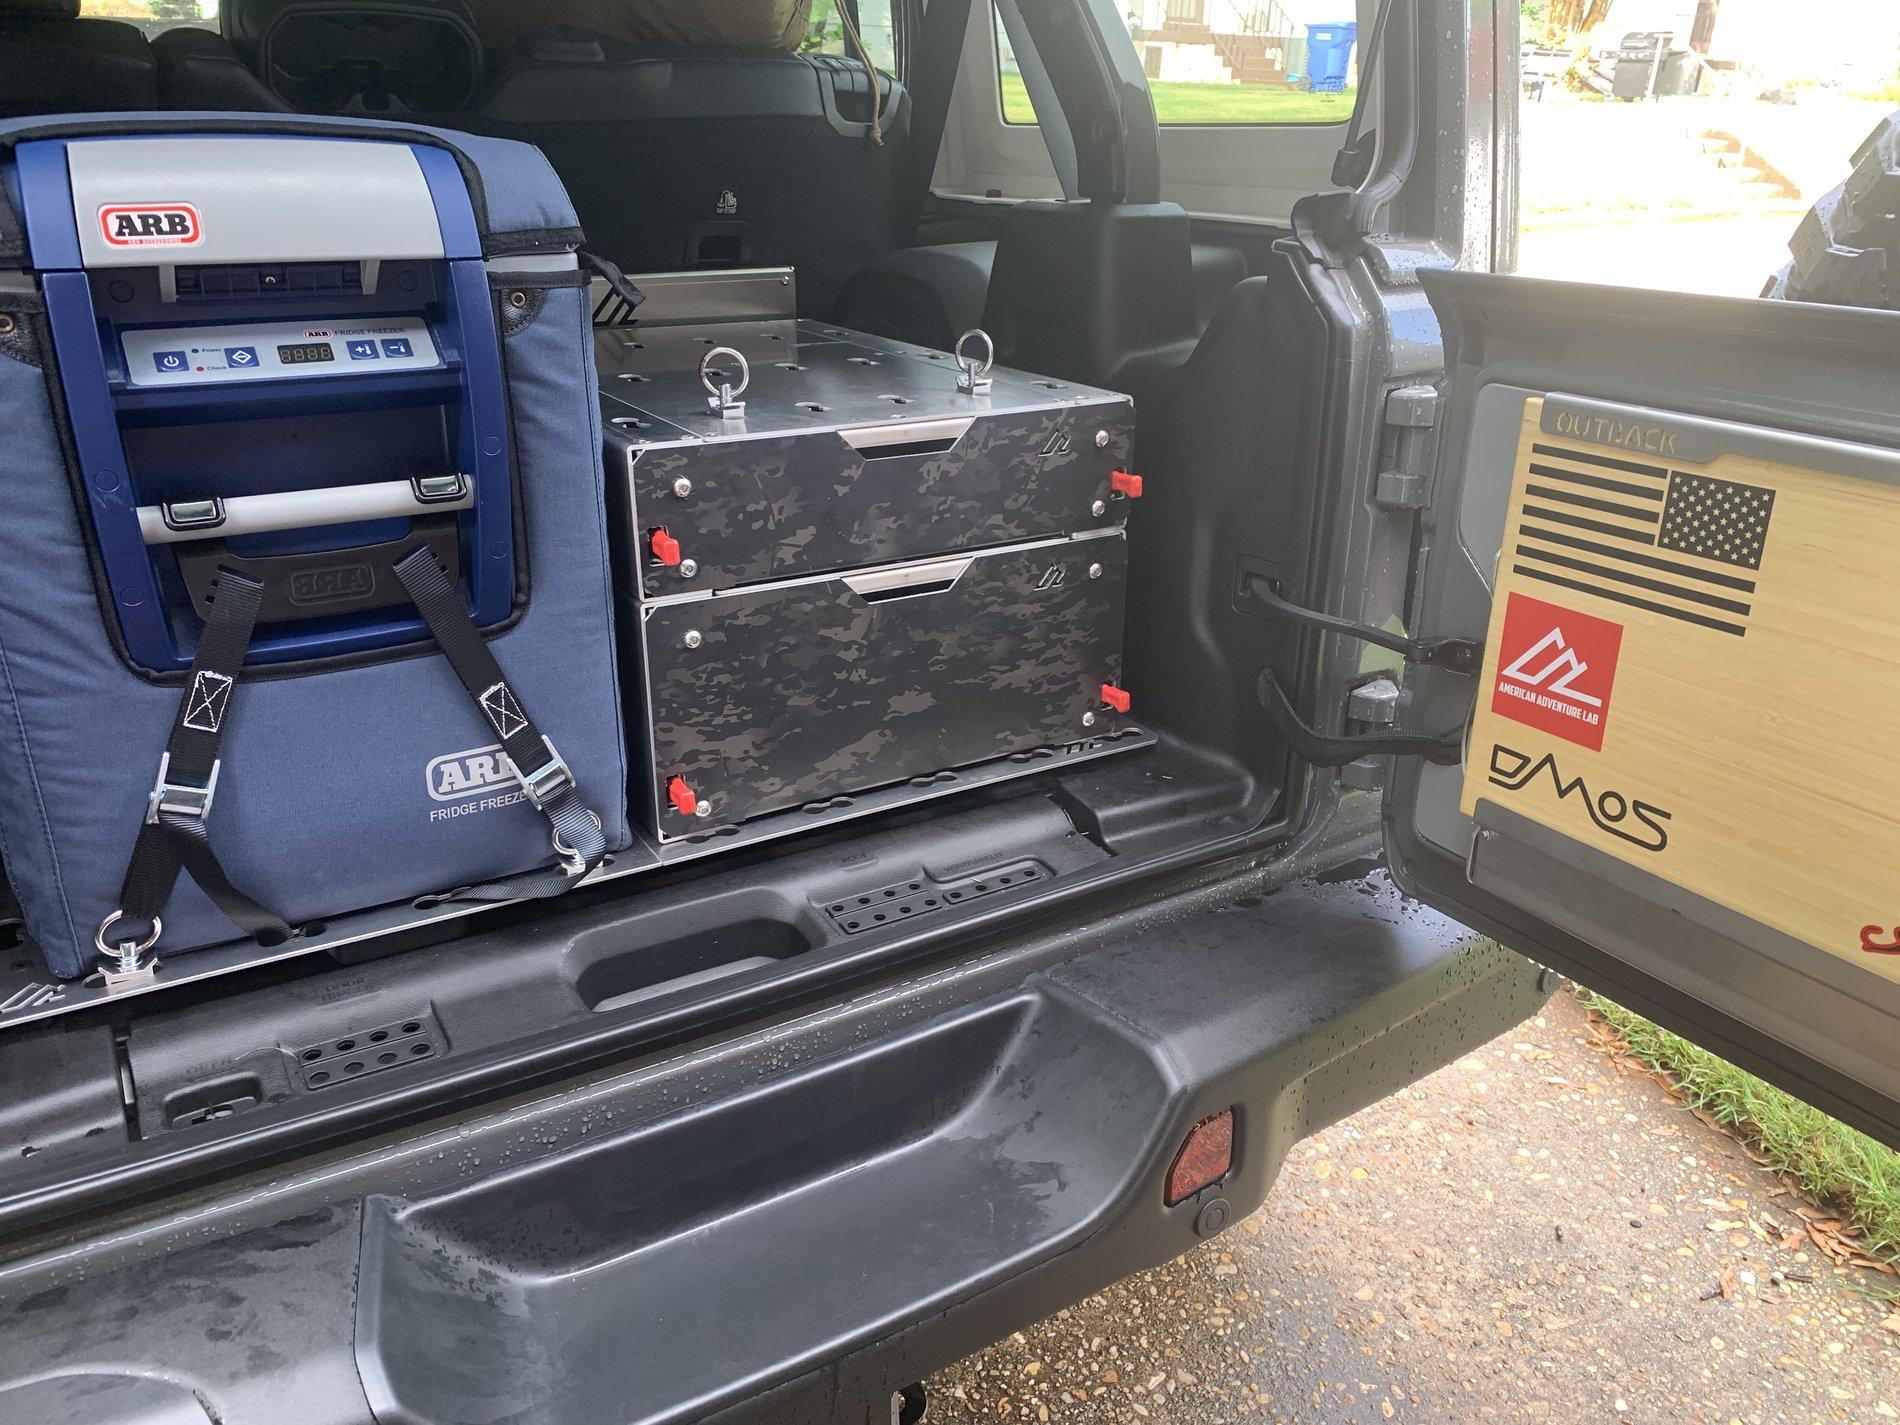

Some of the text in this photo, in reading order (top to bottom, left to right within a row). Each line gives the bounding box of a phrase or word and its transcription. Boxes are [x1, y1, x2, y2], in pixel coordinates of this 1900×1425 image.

[115, 213, 190, 236] ARB
[1557, 412, 1677, 454] OUTBACK
[1498, 681, 1599, 725] AMERICAN ADVENTURE LAB
[430, 791, 527, 822] FRIDGE FREEZE
[1488, 744, 1672, 851] DMOS
